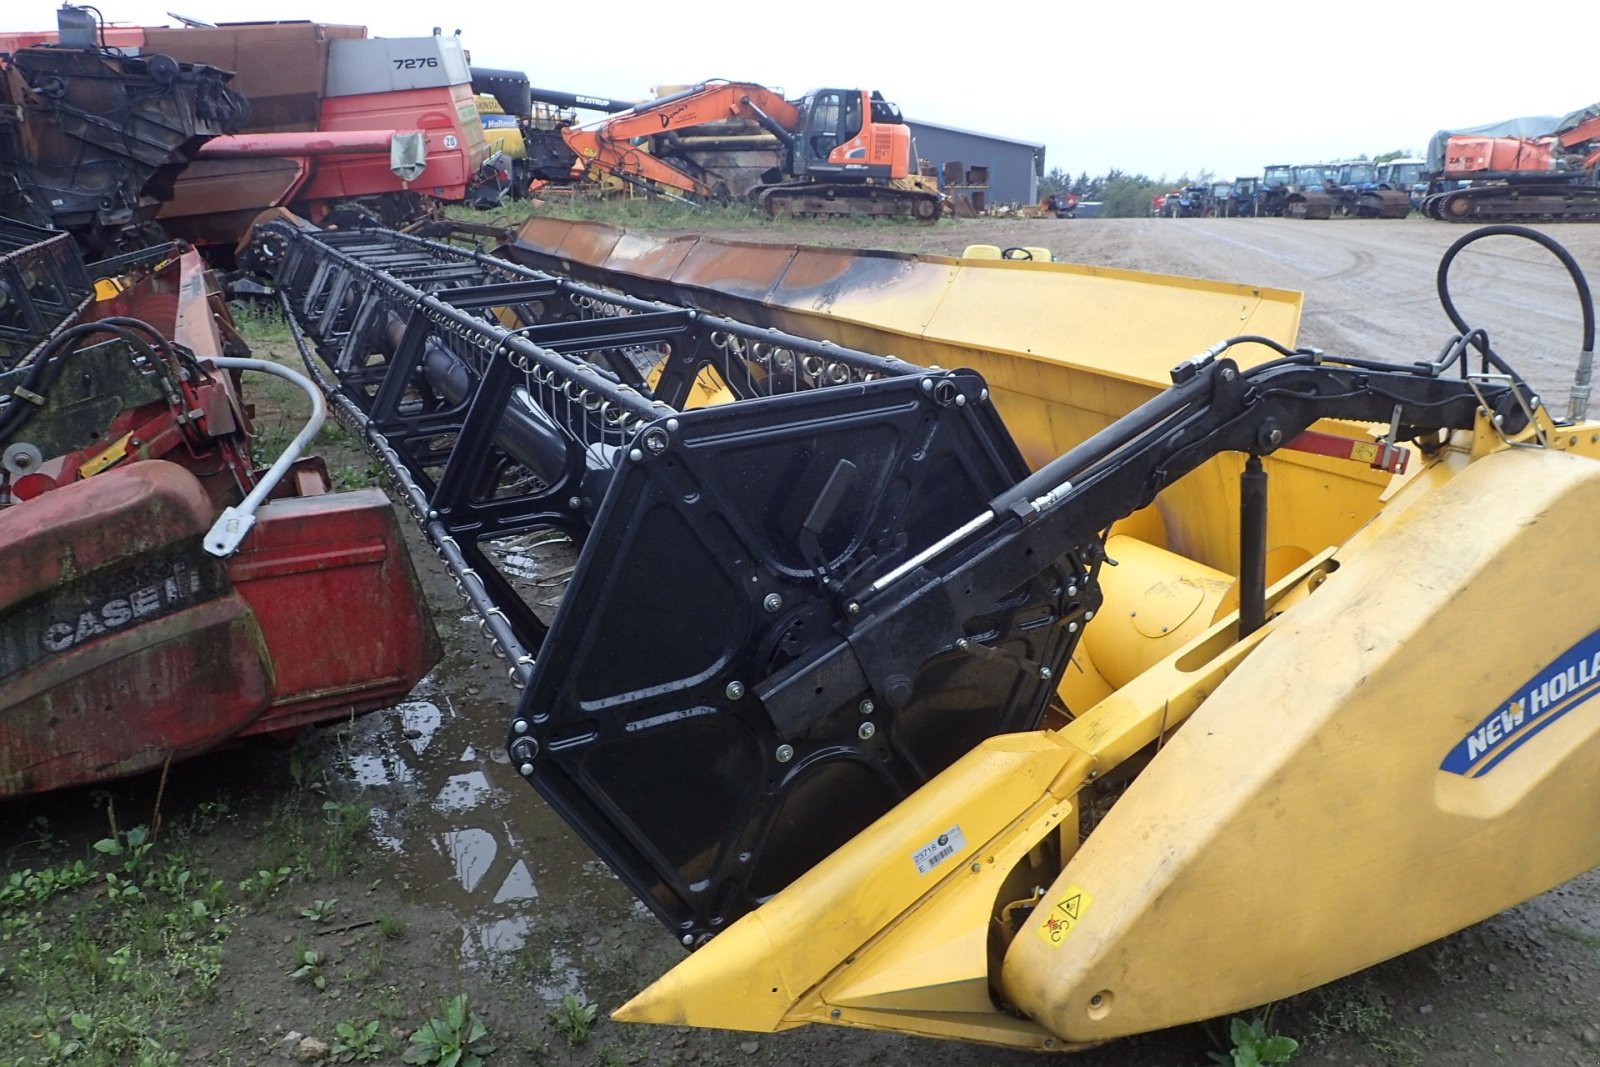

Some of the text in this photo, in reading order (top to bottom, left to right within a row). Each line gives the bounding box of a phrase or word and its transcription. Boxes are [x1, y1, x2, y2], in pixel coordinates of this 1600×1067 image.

[393, 57, 438, 70] 7276
[575, 95, 610, 107] BEJSTRUP
[487, 119, 518, 129] Holland
[445, 137, 455, 147] 20
[43, 584, 160, 651] CASE
[1467, 697, 1526, 761] NEW
[913, 843, 938, 863] 23718
